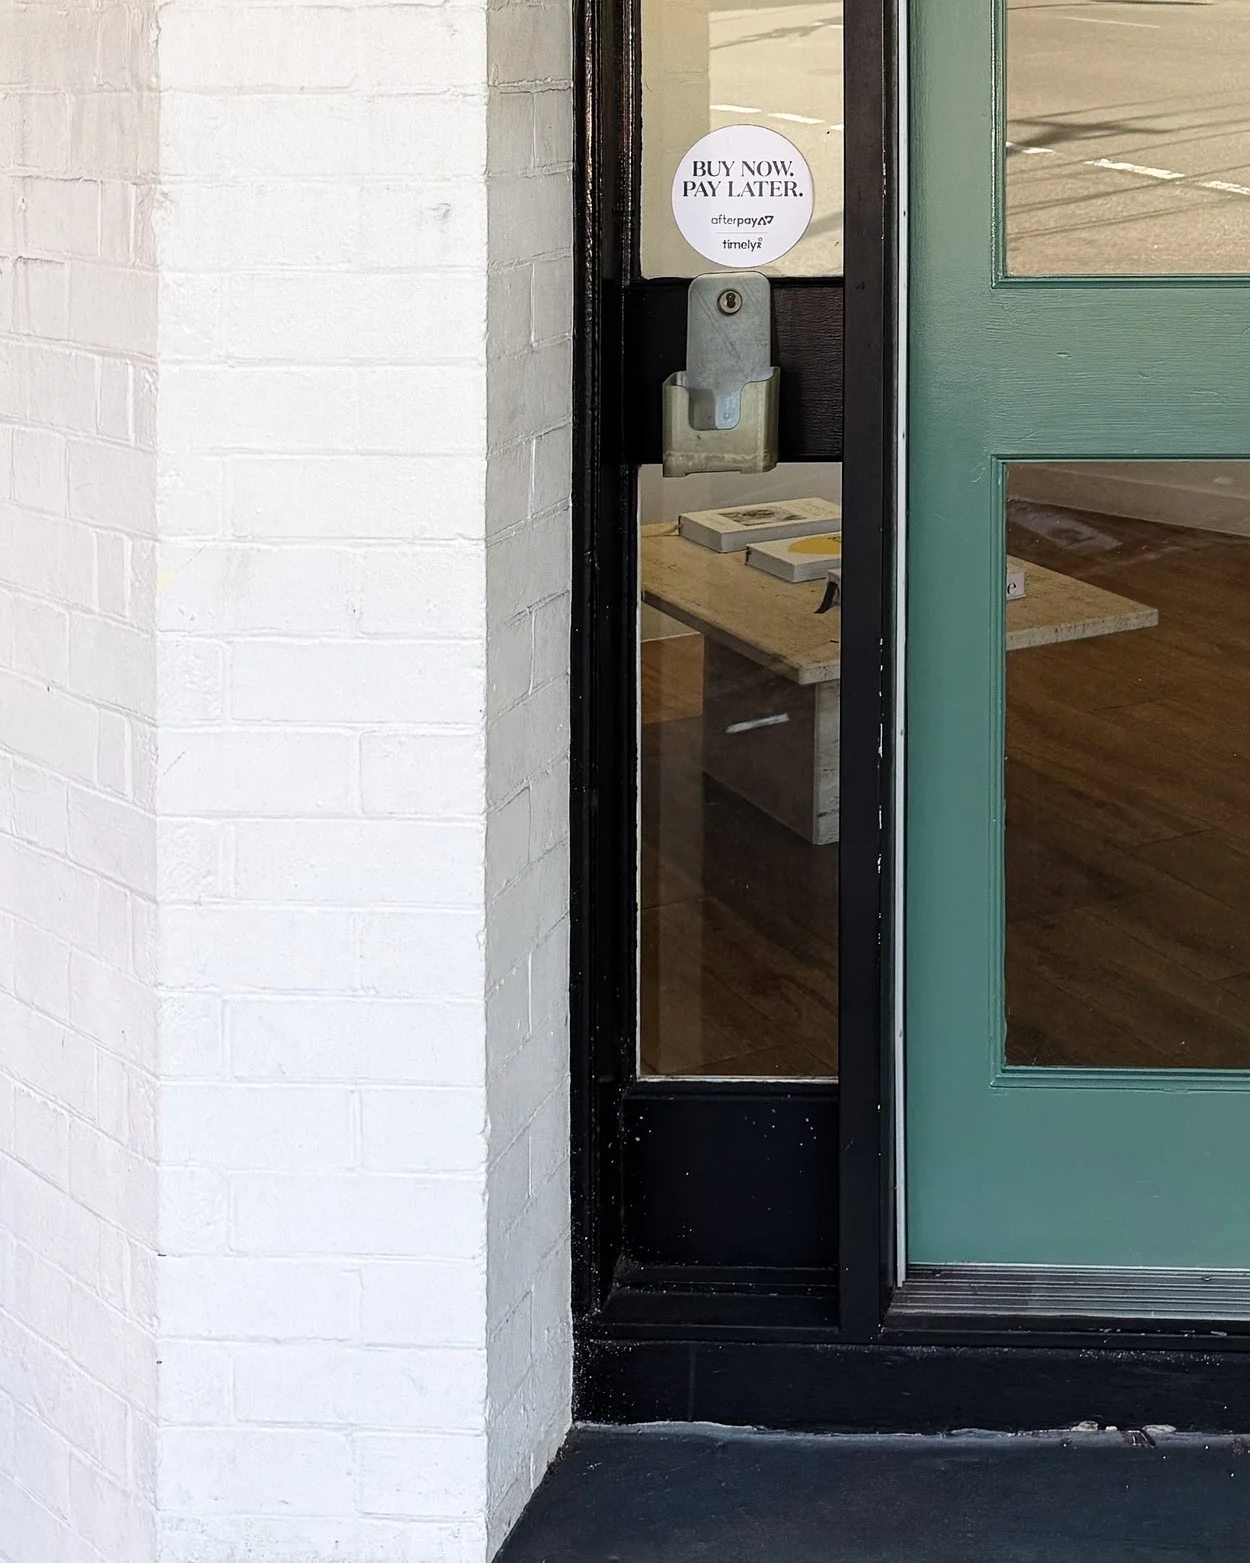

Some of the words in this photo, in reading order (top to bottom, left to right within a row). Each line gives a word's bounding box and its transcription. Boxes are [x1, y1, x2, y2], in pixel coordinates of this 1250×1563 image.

[692, 160, 735, 178] BUY
[741, 160, 795, 178] NOW.
[683, 180, 722, 198] PAY
[728, 180, 804, 198] LATER.
[711, 214, 758, 228] afterpay
[722, 239, 759, 252] timely
